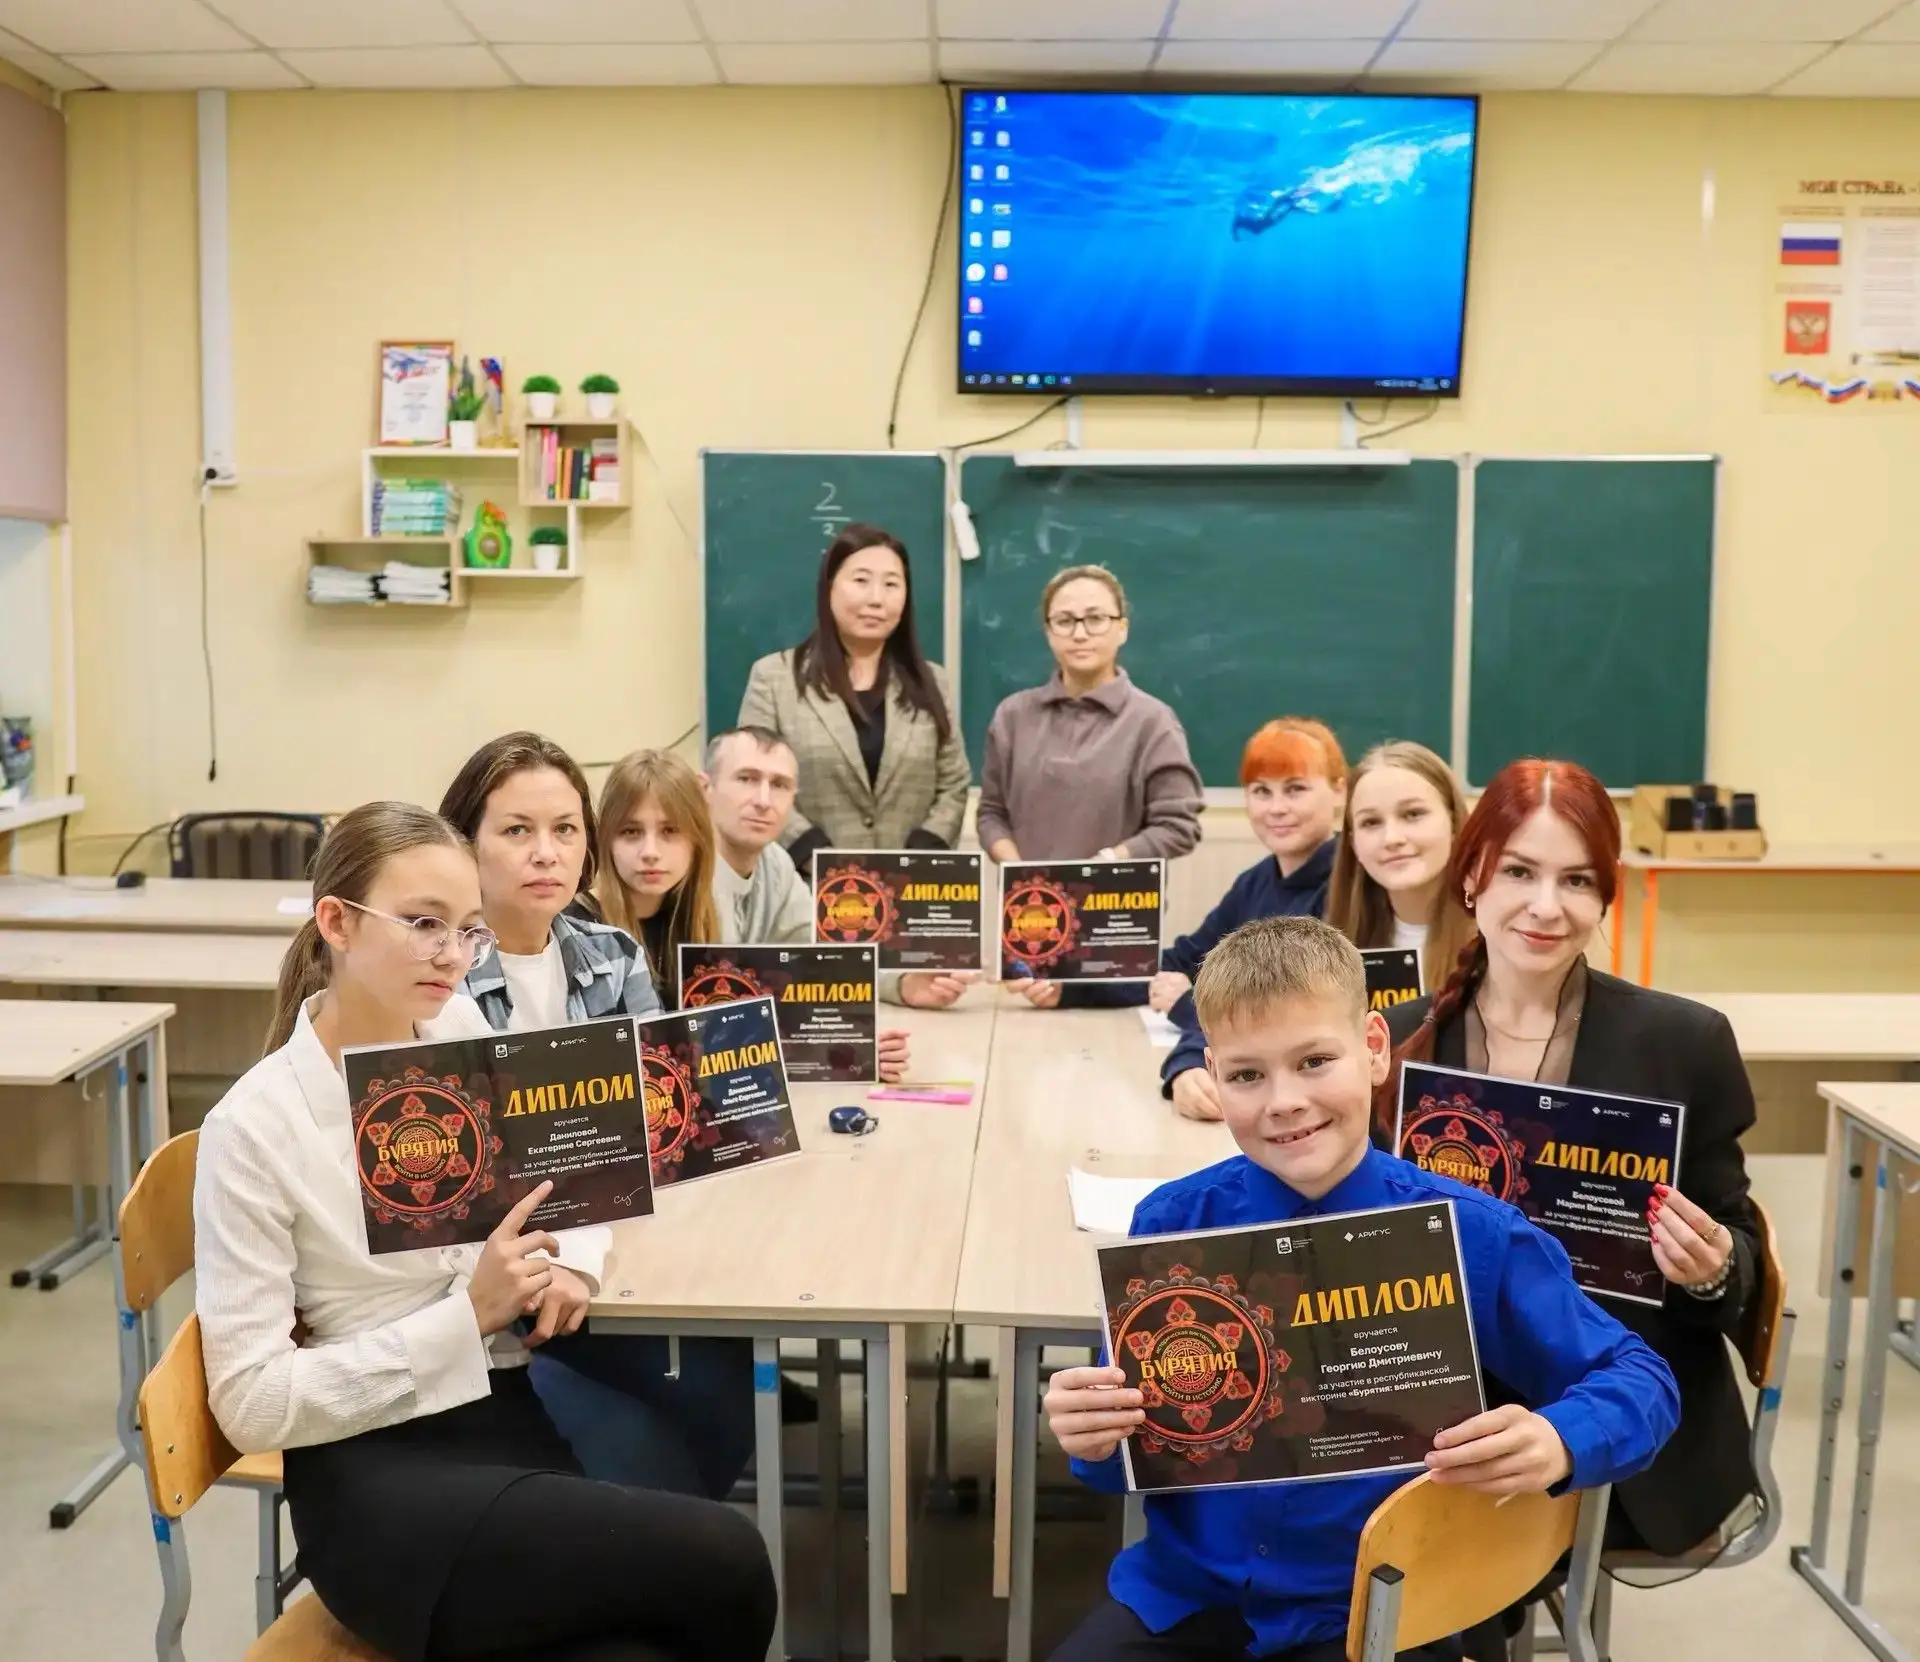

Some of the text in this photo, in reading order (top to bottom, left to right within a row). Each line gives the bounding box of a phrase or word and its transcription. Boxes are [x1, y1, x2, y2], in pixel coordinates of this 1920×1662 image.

[814, 482, 842, 511] 2
[900, 883, 979, 901] ДИПЛОМ
[1083, 891, 1159, 911] ДИПЛОМ
[780, 983, 872, 1003] ДИПЛОМ
[1370, 988, 1418, 1010] ЛОМ
[560, 1037, 587, 1047] АРИГУС
[698, 1041, 778, 1078] ДИПЛОМ
[503, 1073, 635, 1118] ДИПЛОМ
[553, 1116, 589, 1128] вручается
[528, 1134, 622, 1155] Екатерине Сергеевне
[549, 1127, 598, 1142] Даниловой
[378, 1137, 459, 1163] БУРЯТИЯ
[533, 1159, 561, 1169] участие
[567, 1147, 628, 1163] республиканской
[509, 1169, 547, 1180] викторине
[547, 1163, 582, 1175] «Бурятия:
[583, 1160, 604, 1169] войти
[610, 1153, 644, 1164] историю»
[1417, 1155, 1490, 1182] БУРЯТИЯ
[1535, 1141, 1669, 1184] ДИПЛОМ
[1556, 1199, 1640, 1219] Марии Викторовне
[1572, 1191, 1625, 1207] Белоусовой
[1357, 1228, 1392, 1239] АРИГУС
[1290, 1272, 1456, 1327] ДИПЛОМ
[1353, 1326, 1398, 1340] вручается
[1350, 1341, 1409, 1357] Белоусову
[1140, 1351, 1238, 1380] БУРЯТИЯ
[1320, 1350, 1443, 1374] Георгию Дмитриевичу
[1301, 1392, 1347, 1403] викторине
[1348, 1385, 1393, 1399] «Бурятия:
[1394, 1381, 1421, 1391] войти
[1428, 1374, 1471, 1387] историю»
[1318, 1382, 1329, 1391] за
[1330, 1378, 1365, 1390] участие
[1373, 1365, 1450, 1385] республиканской
[1309, 1430, 1380, 1444] Генеральный директор
[1327, 1447, 1365, 1458] Скосырская
